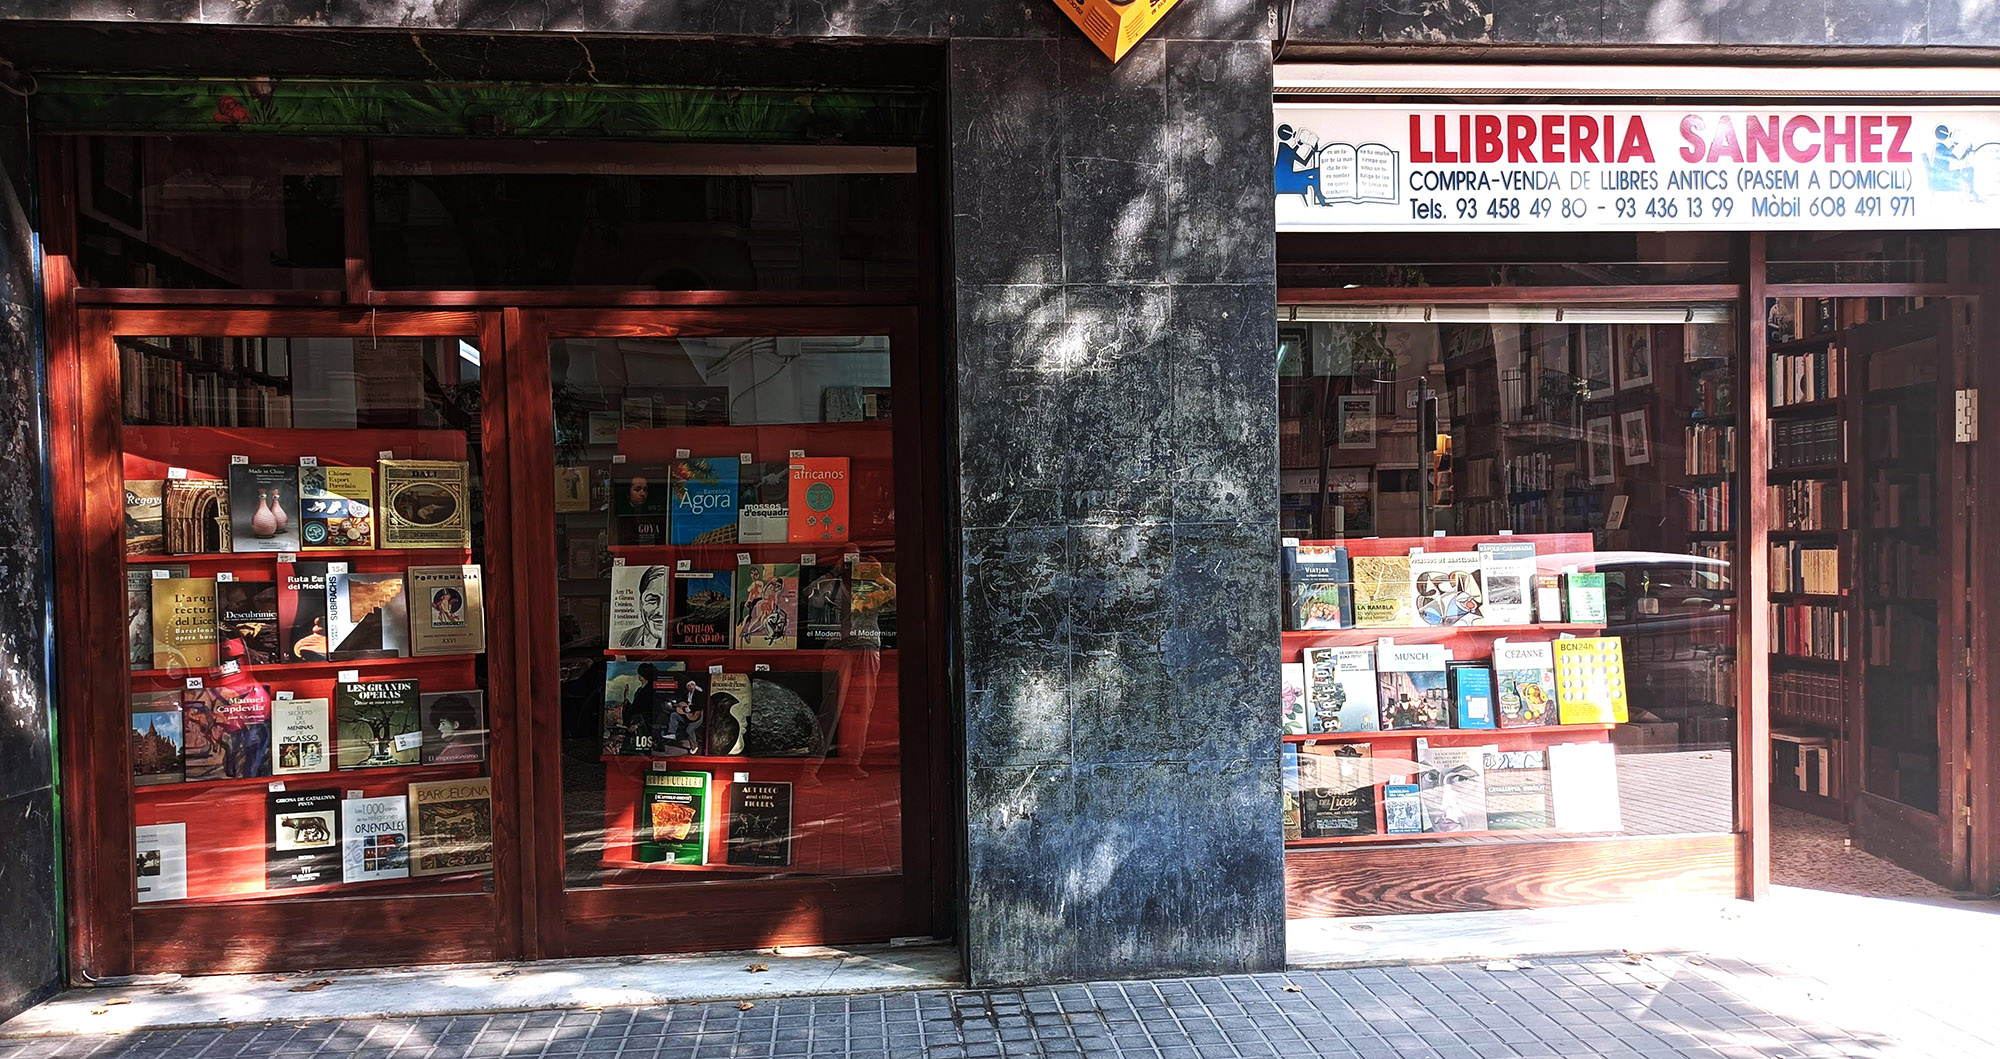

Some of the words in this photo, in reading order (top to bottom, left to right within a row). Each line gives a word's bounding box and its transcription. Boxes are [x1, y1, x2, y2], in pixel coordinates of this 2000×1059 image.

[1409, 114, 1655, 163] LLIBRERIA
[1679, 114, 1912, 163] SANCHEZ
[1409, 170, 1560, 191] COMPRA-VENDA
[1570, 170, 1590, 190] DE
[1601, 170, 1658, 190] LLIBRES
[1667, 170, 1728, 190] ANTICS
[1737, 168, 1799, 192] (PASEM
[1808, 170, 1821, 190] A
[1830, 168, 1912, 191] DOMICILI)
[1409, 198, 1447, 219] Tels.
[1456, 198, 1478, 218] 93
[1487, 198, 1520, 218] 458
[1529, 198, 1551, 218] 49
[1561, 198, 1587, 218] 80
[1615, 198, 1636, 217] 93
[1645, 197, 1678, 218] 436
[1687, 197, 1702, 218] 13
[1712, 197, 1734, 217] 99
[1752, 195, 1800, 217] Mòbil
[1809, 196, 1846, 217] 608
[1855, 196, 1881, 217] 491
[1890, 196, 1915, 217] 971
[793, 469, 844, 480] africanos
[679, 487, 731, 515] Àgora
[638, 523, 660, 534] GOYA
[329, 576, 338, 621] SUBIRACHS
[175, 617, 190, 626] del
[1560, 643, 1594, 651] BCN24h
[1395, 653, 1429, 661] MUNCH
[346, 683, 366, 693] LES
[366, 683, 411, 692] GRANDS
[1316, 649, 1339, 729] BARCELONA
[229, 696, 264, 704] Manuel
[358, 691, 401, 700] OPERAS
[217, 704, 264, 714] Capdevila
[283, 734, 319, 743] PICASSO
[635, 736, 653, 748] LOS
[418, 785, 489, 802] BARCELONA
[1329, 796, 1358, 811] Liceu
[355, 821, 405, 834] ORIENTALES
